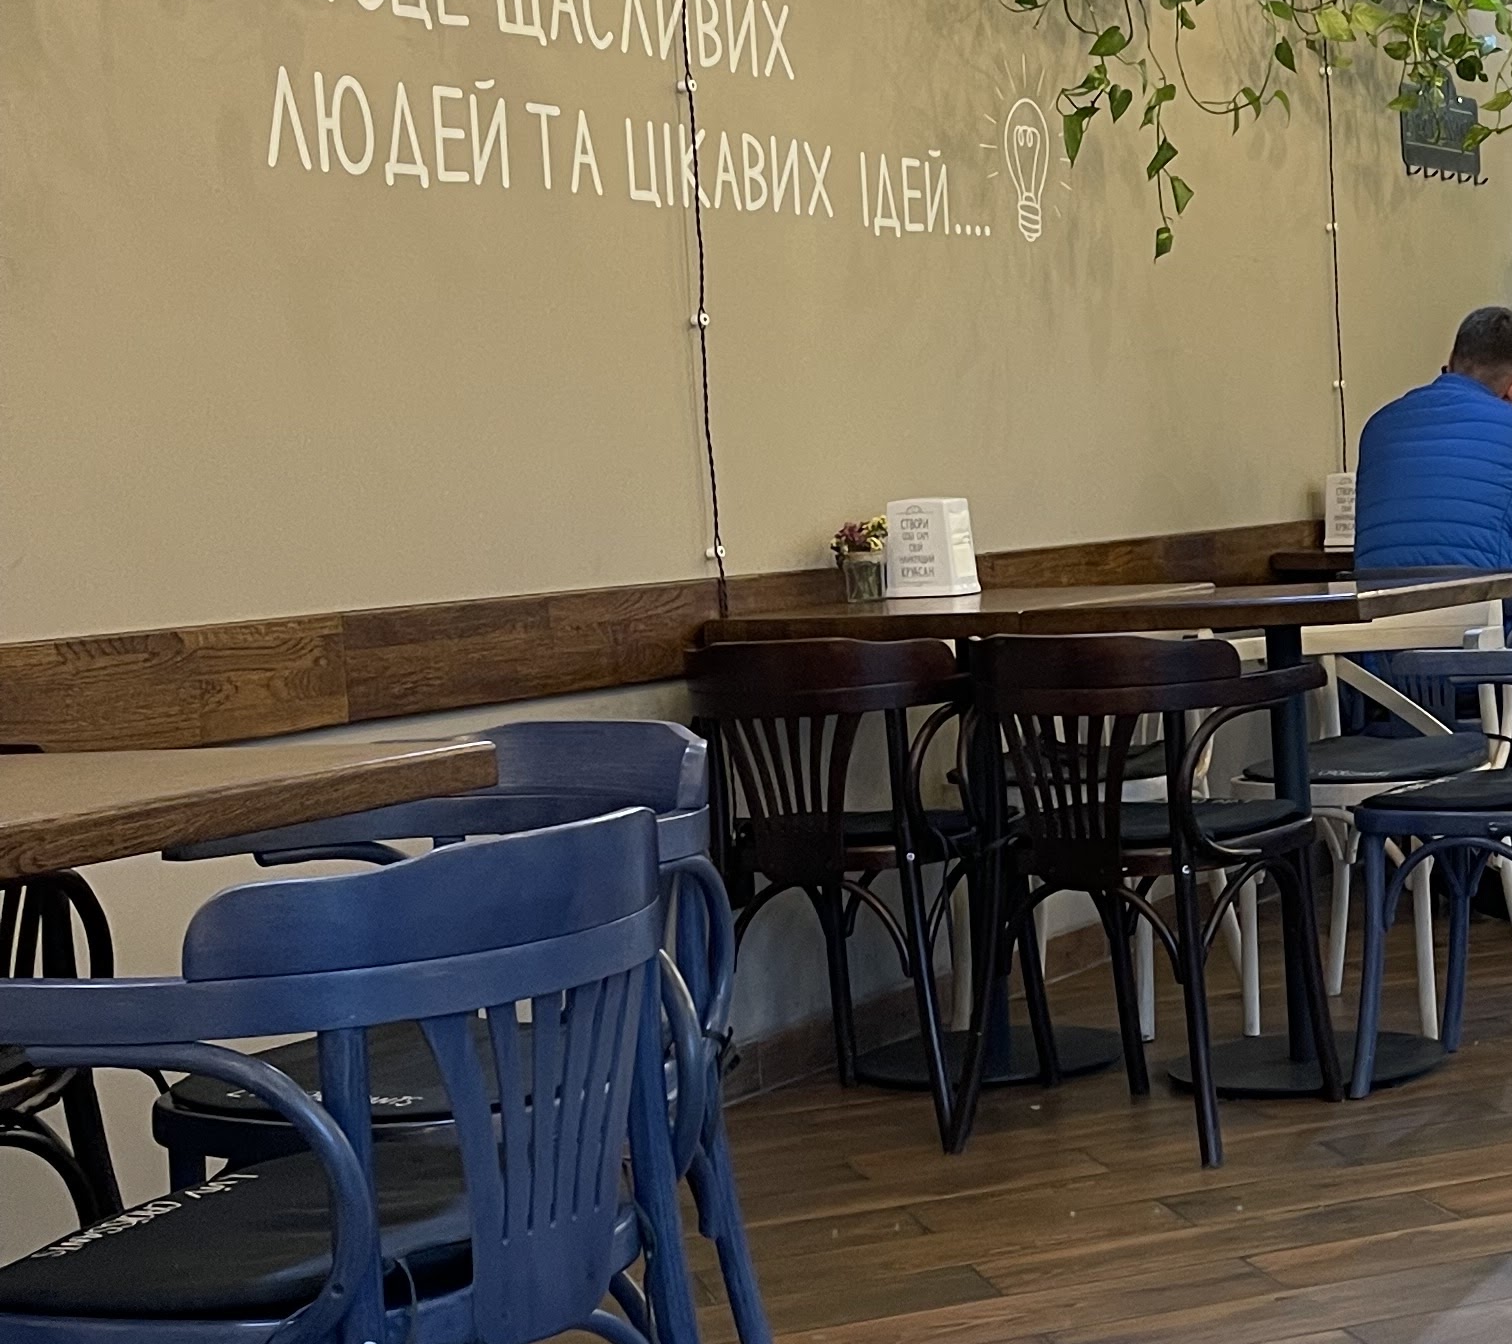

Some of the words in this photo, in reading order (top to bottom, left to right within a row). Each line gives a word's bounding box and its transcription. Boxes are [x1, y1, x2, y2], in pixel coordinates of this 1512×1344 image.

[268, 66, 510, 188] ЛЮДЕЙ
[525, 102, 603, 196] ТА
[625, 117, 834, 217] ЦІКАВИХ
[900, 518, 929, 530] СТВОРИ
